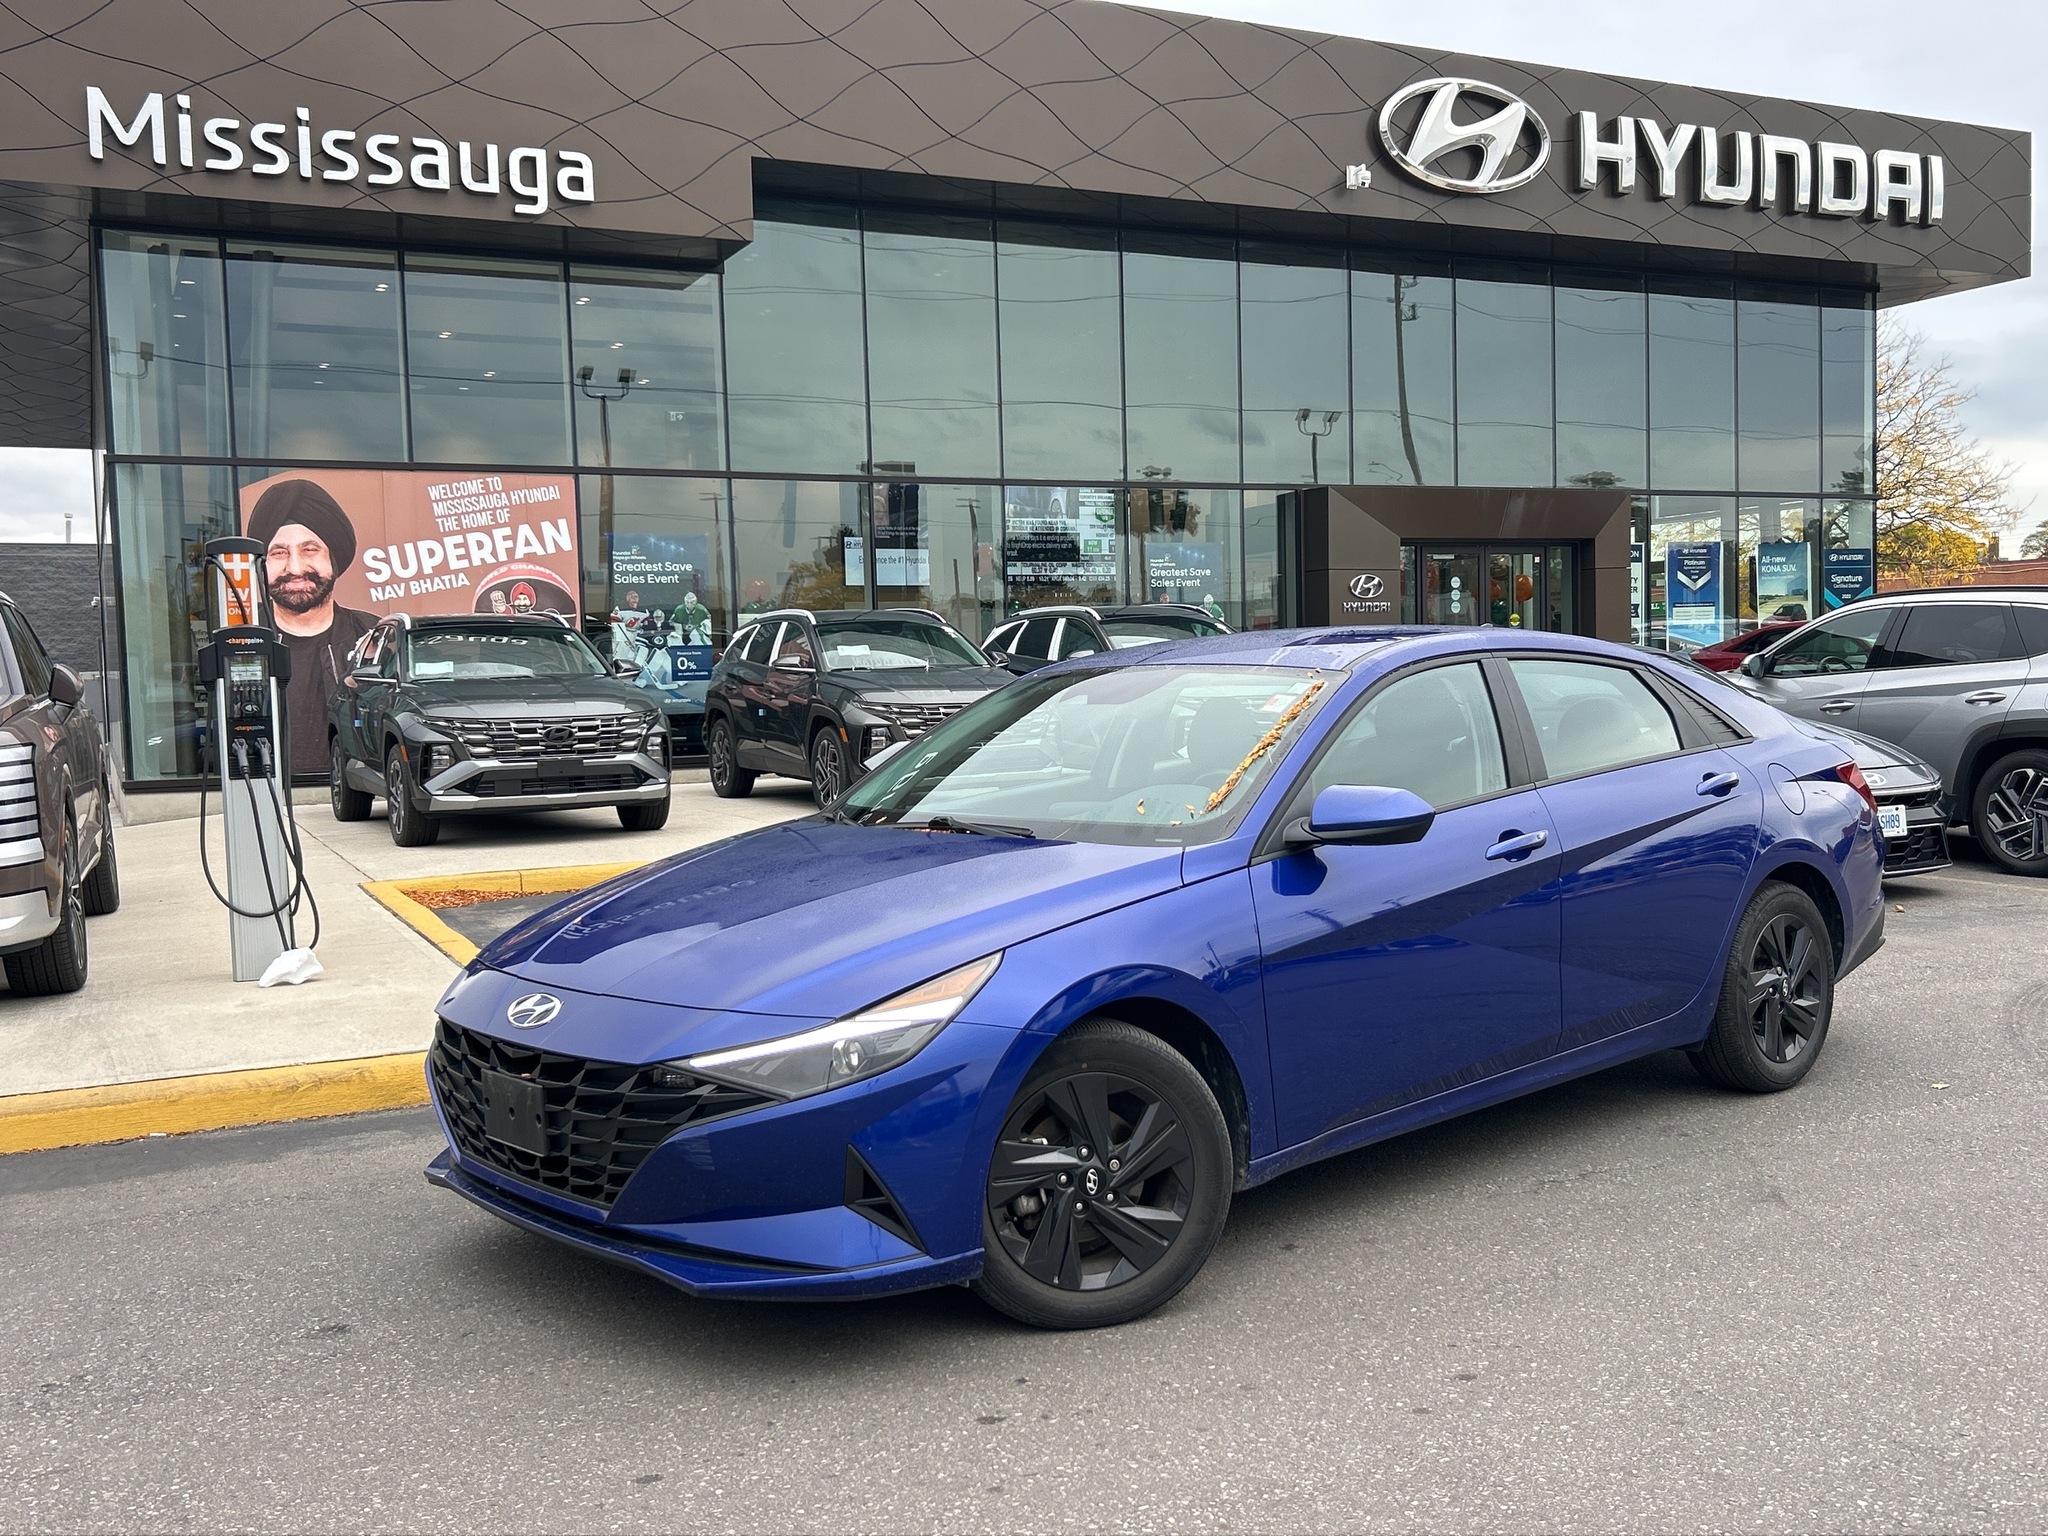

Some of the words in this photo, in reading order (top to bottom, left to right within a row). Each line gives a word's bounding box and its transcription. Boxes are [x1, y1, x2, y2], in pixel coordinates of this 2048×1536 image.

[86, 85, 595, 215] Mississauga
[1576, 110, 1943, 226] HYUNDAI
[427, 479, 486, 501] WELCOME
[486, 476, 503, 491] TO
[432, 492, 510, 517] MISSISSAUGA
[509, 485, 561, 505] HYUNDAI
[436, 516, 461, 533] THE
[461, 510, 495, 529] HOME
[495, 508, 511, 523] OF
[362, 518, 573, 584] SUPERFAN
[1761, 555, 1787, 564] All-new
[613, 561, 663, 572] Greatest
[664, 561, 693, 572] Save
[1150, 567, 1188, 577] Greatest
[1189, 567, 1211, 577] Save
[1761, 564, 1782, 573] KONA
[614, 574, 646, 584] Sales
[647, 573, 680, 584] Event
[1150, 578, 1175, 588] Sales
[1176, 578, 1201, 587] Event
[1830, 574, 1863, 584] Signature
[369, 582, 406, 602] NAV
[409, 572, 471, 595] BHATIA
[227, 587, 250, 601] EV
[228, 607, 251, 616] ONY
[1343, 602, 1391, 613] HYUNDAI
[677, 656, 697, 670] 0%
